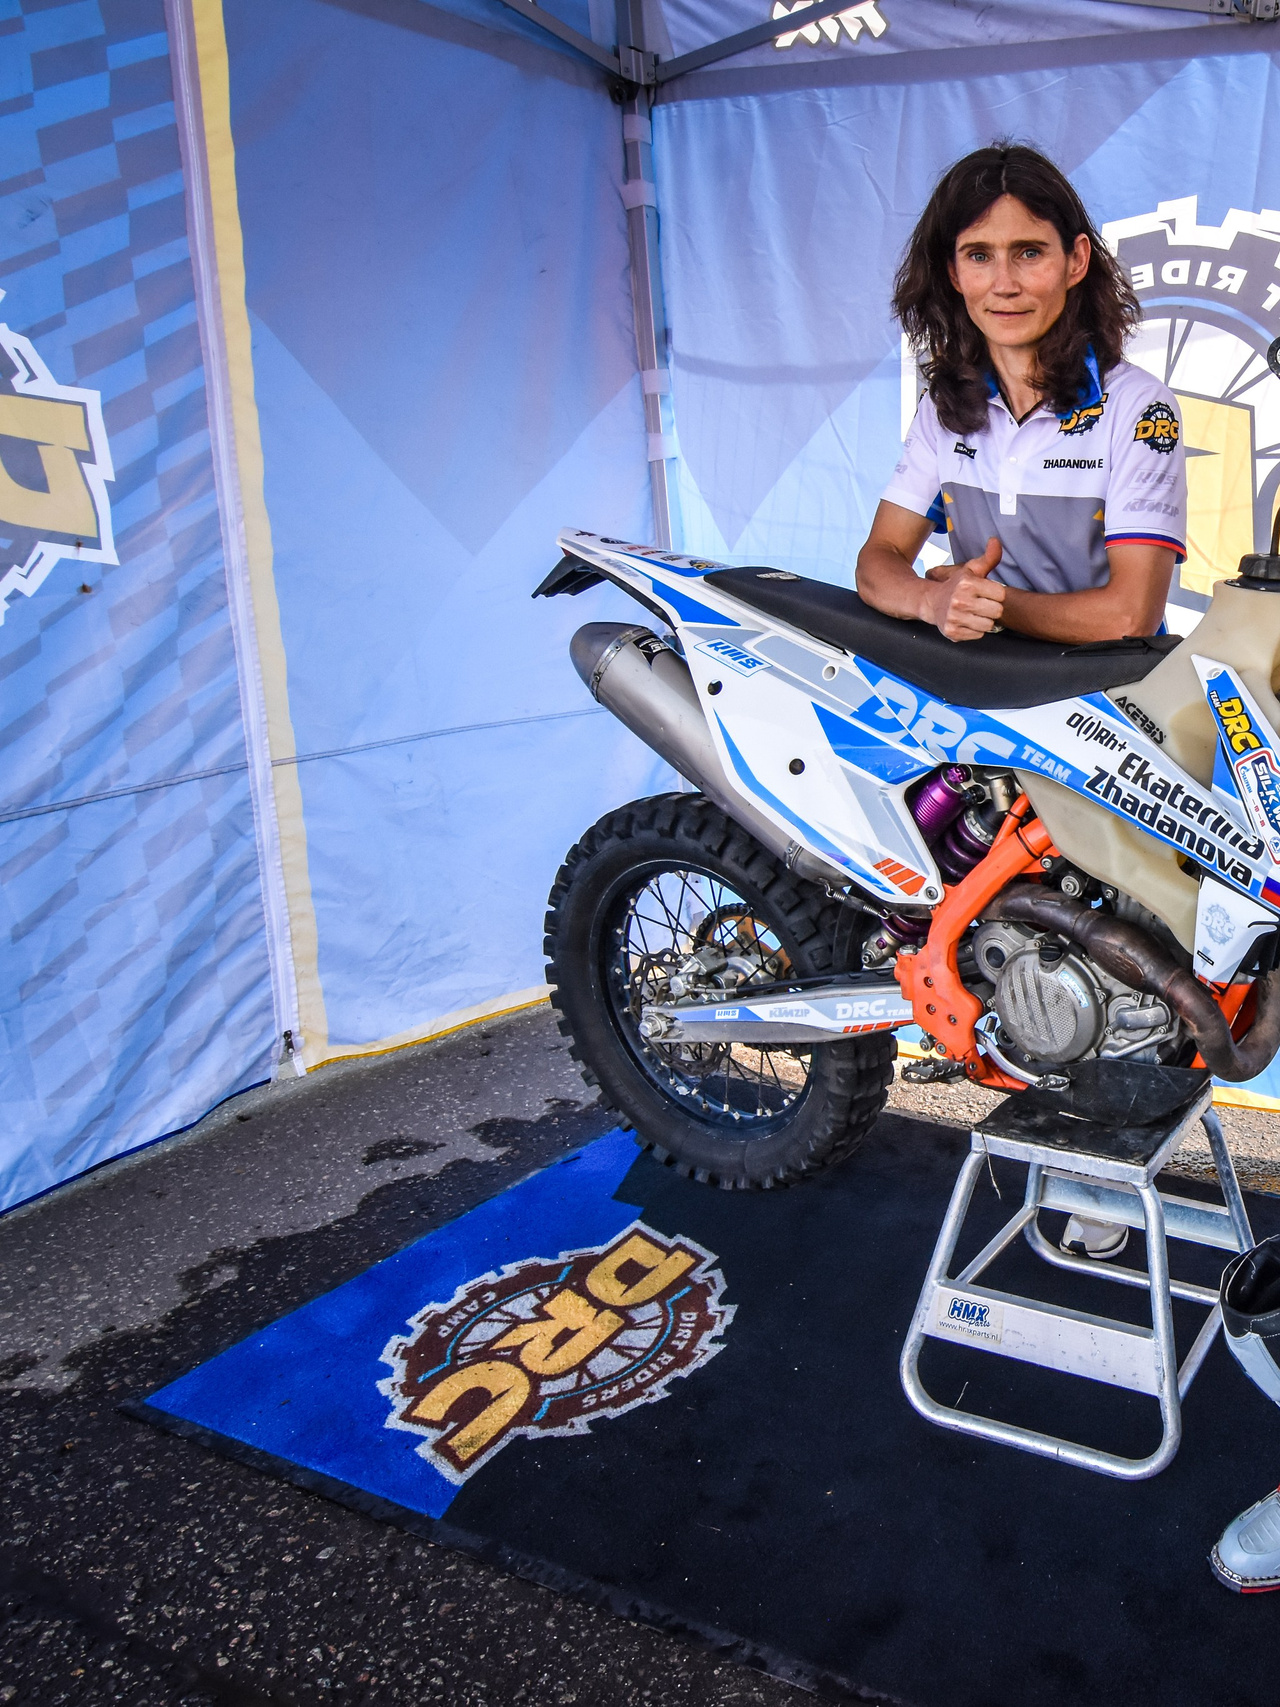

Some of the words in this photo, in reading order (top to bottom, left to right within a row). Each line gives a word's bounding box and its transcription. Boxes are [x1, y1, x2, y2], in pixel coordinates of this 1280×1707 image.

[1135, 419, 1180, 441] DRC
[1043, 459, 1096, 469] ZHADANOVA
[1098, 459, 1103, 468] E
[850, 676, 1018, 763] DRC
[1020, 746, 1073, 783] TEAM
[1209, 690, 1222, 710] TEAM
[1218, 698, 1261, 753] DRC
[1254, 761, 1279, 804] SILK
[1259, 791, 1276, 824] RALLY
[1085, 766, 1253, 888] Zhadanova
[1200, 909, 1236, 940] DRC
[769, 1007, 811, 1018] KTMZIP
[836, 999, 887, 1019] DRC
[887, 1007, 914, 1017] TEAM
[437, 1291, 498, 1339] CAMP
[948, 1298, 989, 1322] HMX
[968, 1317, 991, 1328] Parts
[410, 1234, 697, 1462] DRC
[674, 1310, 700, 1351] DIRT
[582, 1353, 677, 1409] RIDERS
